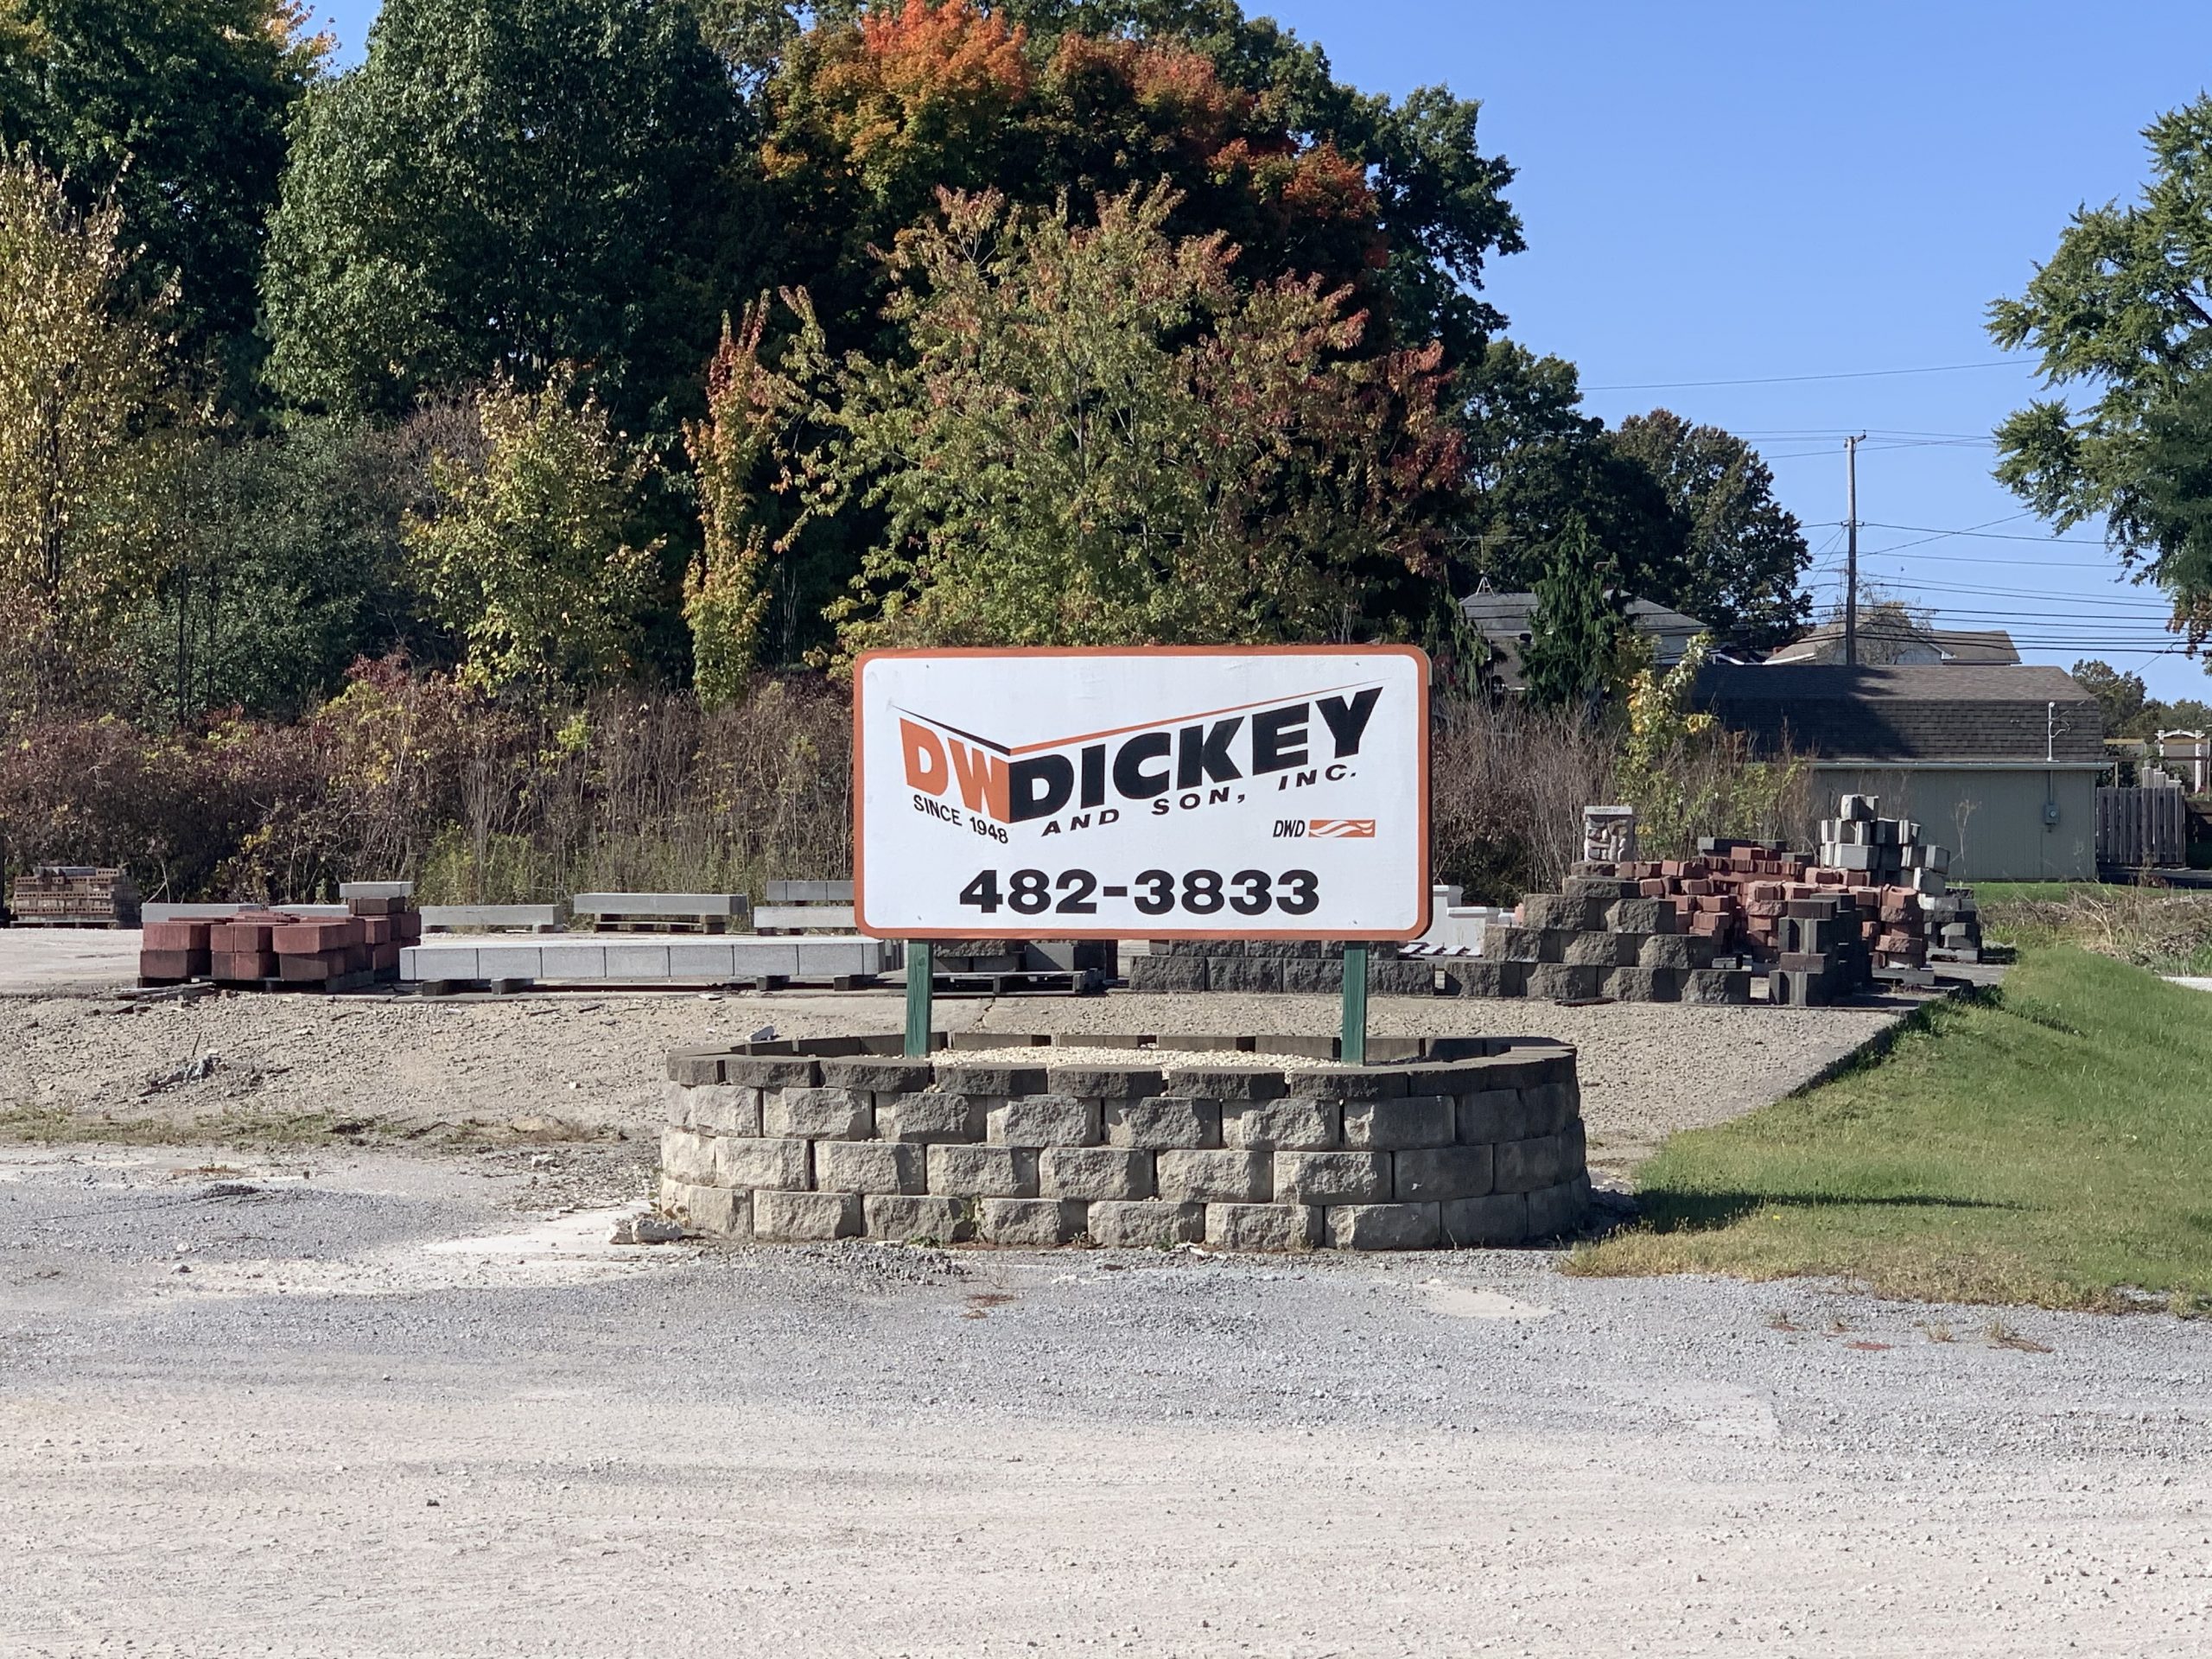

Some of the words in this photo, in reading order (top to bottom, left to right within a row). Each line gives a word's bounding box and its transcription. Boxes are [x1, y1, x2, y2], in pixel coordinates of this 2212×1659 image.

[899, 717, 1010, 823] DW
[1009, 686, 1383, 823] DICKEY
[913, 794, 963, 827] SINCE
[969, 816, 1010, 844] 1948
[1041, 808, 1120, 837] AND
[1151, 786, 1246, 816] SON,
[1278, 764, 1358, 791] INC.
[1272, 819, 1306, 838] DWD
[959, 868, 1320, 916] 482-3833
